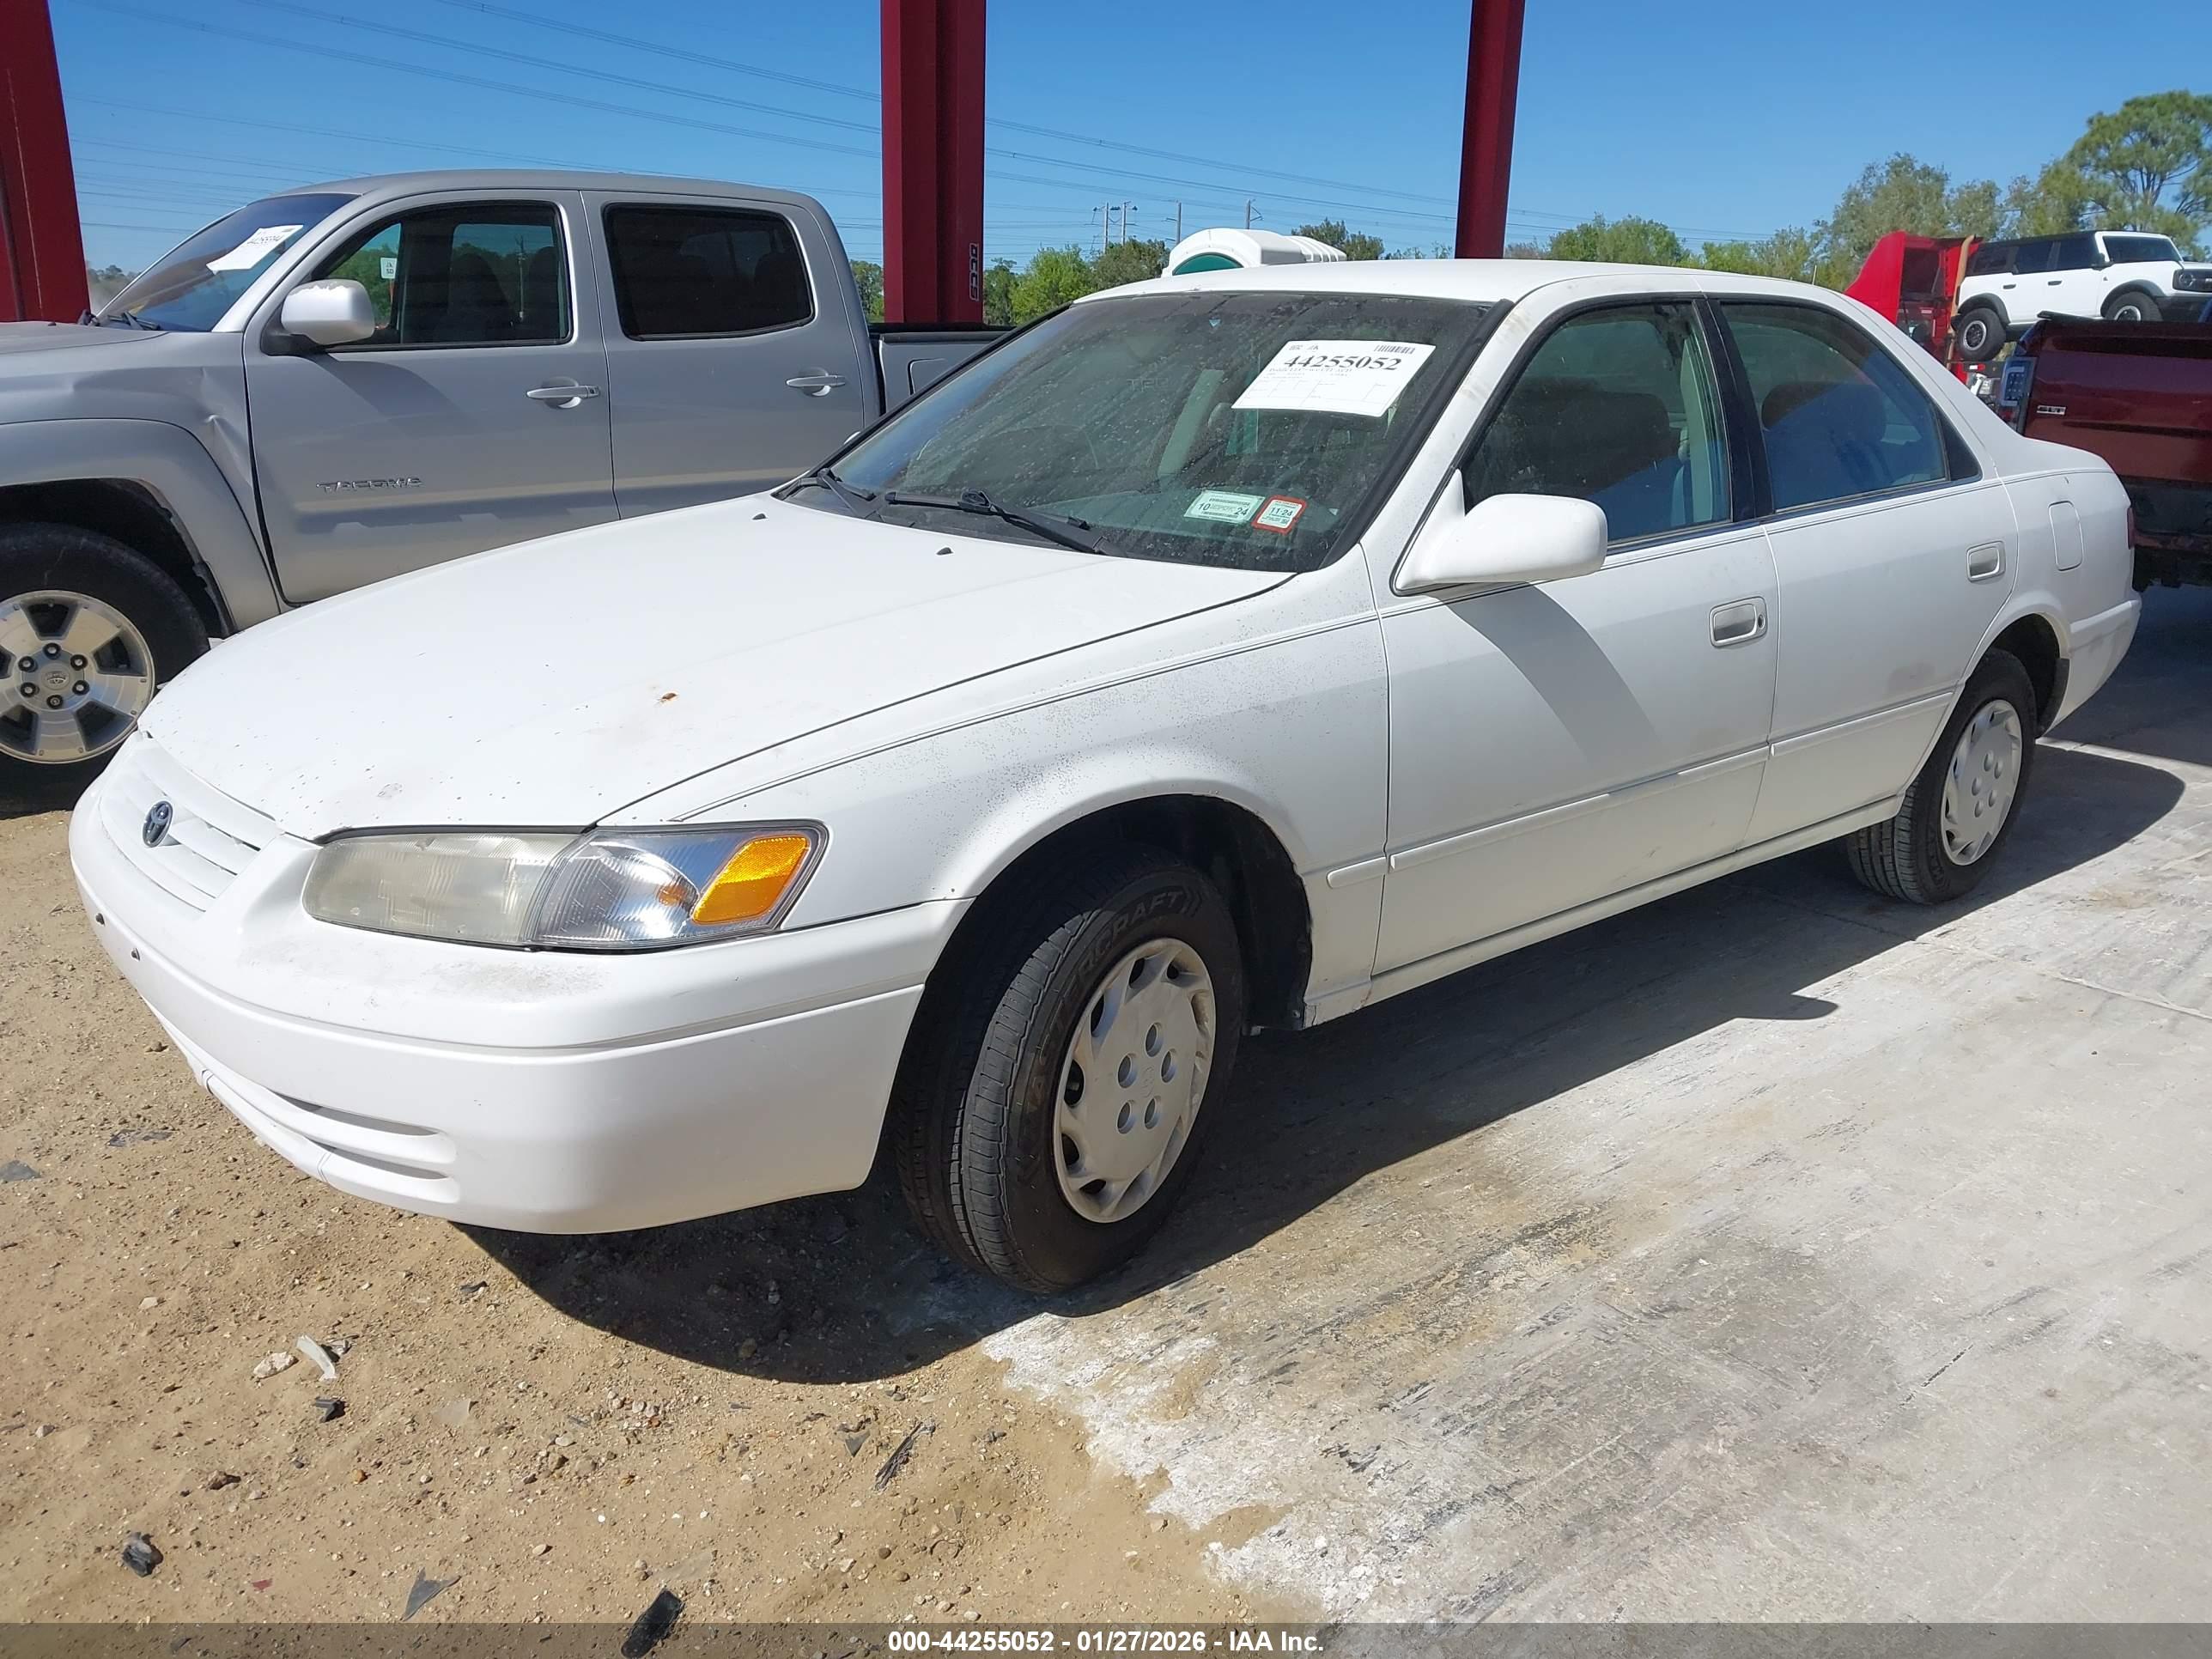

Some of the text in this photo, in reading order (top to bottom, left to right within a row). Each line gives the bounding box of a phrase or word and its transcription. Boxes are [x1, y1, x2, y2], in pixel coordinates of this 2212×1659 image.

[1284, 355, 1402, 371] 44255052
[316, 477, 422, 492] TACOMA
[1235, 507, 1249, 516] 24
